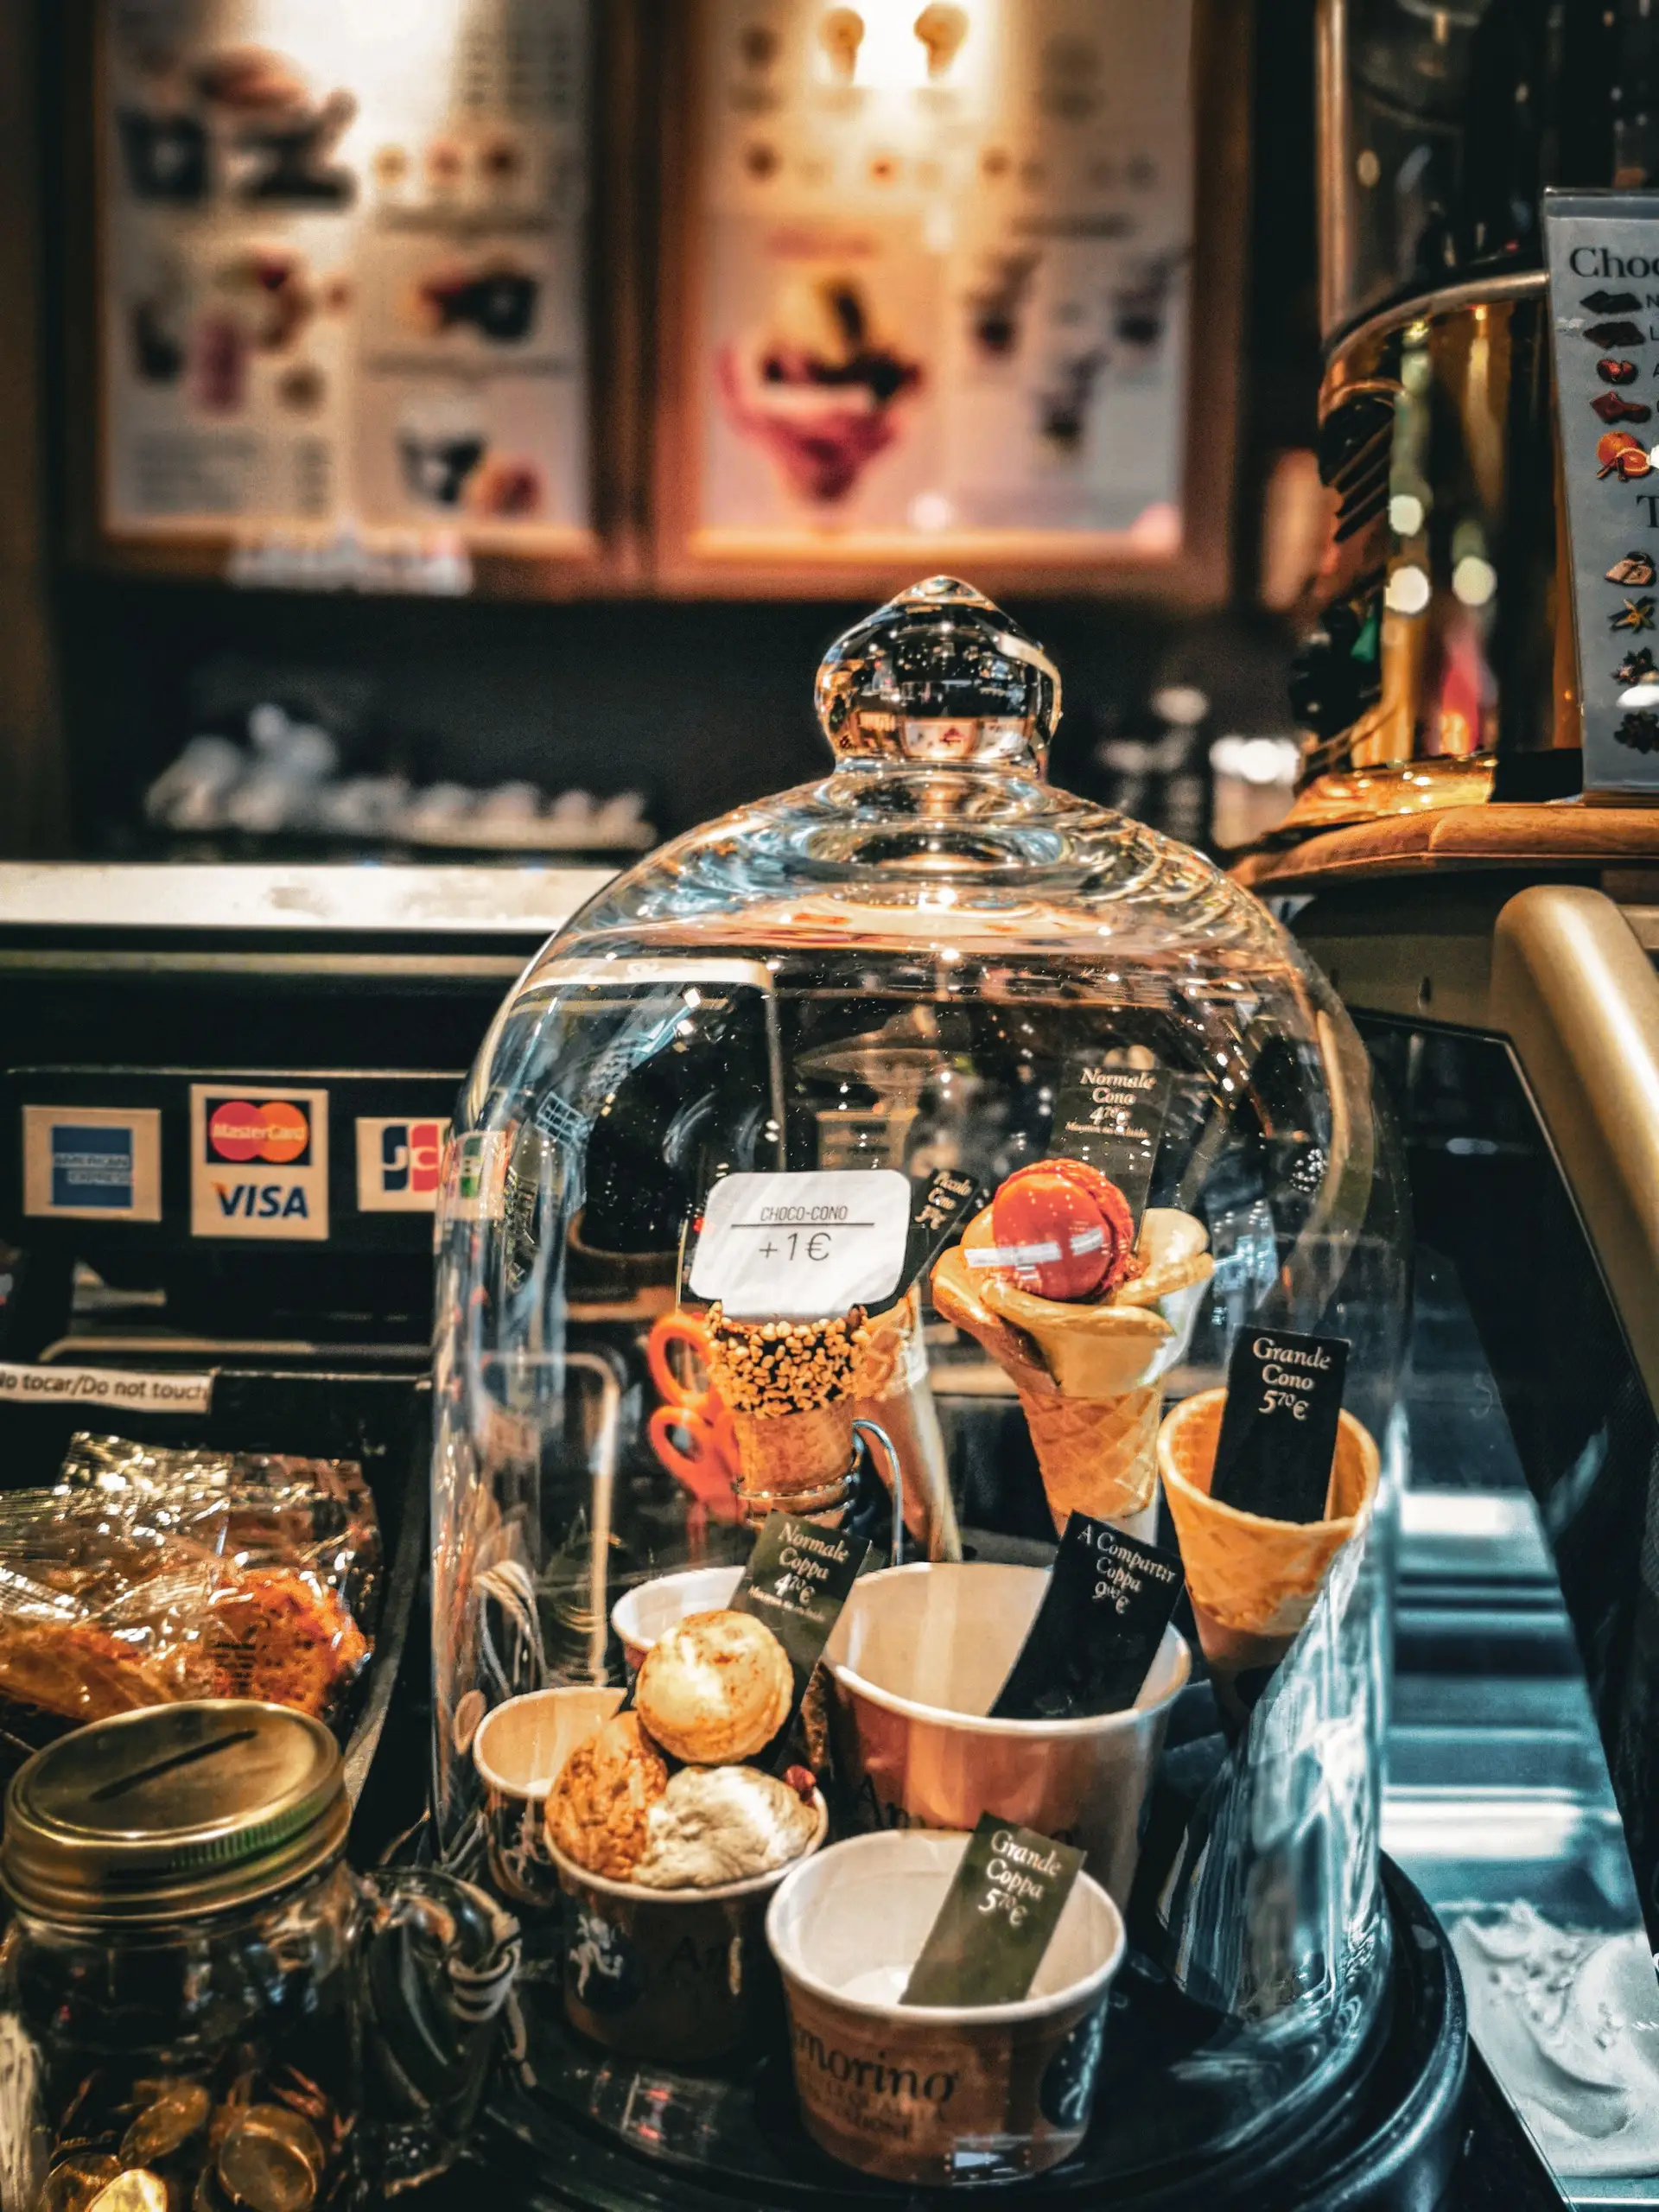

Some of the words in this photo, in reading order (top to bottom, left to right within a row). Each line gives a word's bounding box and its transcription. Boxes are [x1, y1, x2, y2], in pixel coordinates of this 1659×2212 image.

[1080, 1067, 1156, 1090] Normale
[1092, 1086, 1136, 1106] Cono
[213, 1122, 306, 1141] MasterCard
[212, 1181, 308, 1219] VISA
[760, 1206, 849, 1222] CHOCO-CONO
[1253, 1337, 1332, 1370] Grande
[114, 1382, 145, 1398] not
[1262, 1363, 1314, 1390] Cono
[778, 1522, 850, 1565] Normale
[1077, 1523, 1092, 1547] A
[1096, 1556, 1143, 1592] Coppa
[991, 1829, 1063, 1878] Grande
[986, 1858, 1045, 1901] Coppa
